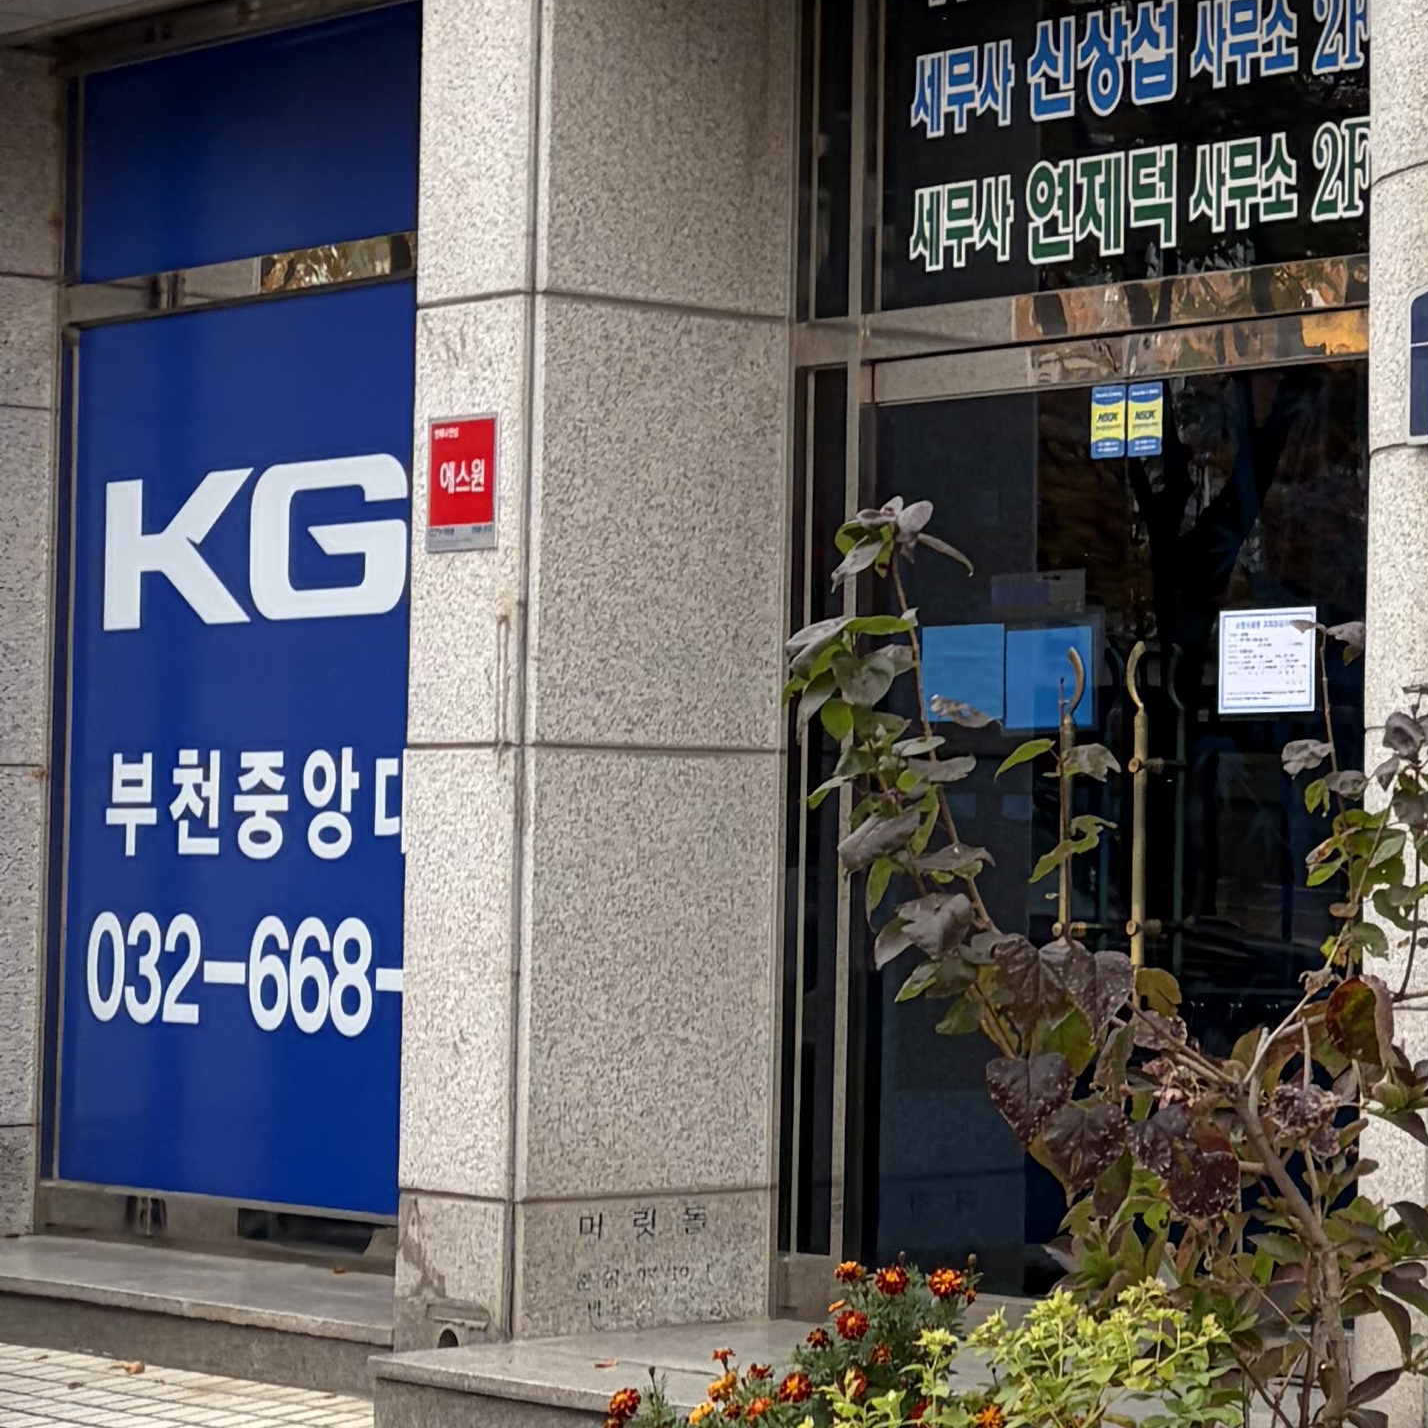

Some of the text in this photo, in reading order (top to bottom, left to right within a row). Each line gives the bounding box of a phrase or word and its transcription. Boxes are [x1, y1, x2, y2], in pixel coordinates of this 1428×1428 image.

[911, 39, 1012, 139] 세무사
[909, 115, 1371, 272] 세무사 연제덕 사무소 2F
[440, 458, 485, 494] 에스원
[103, 453, 409, 632] KG
[86, 910, 404, 1038] 032-668-
